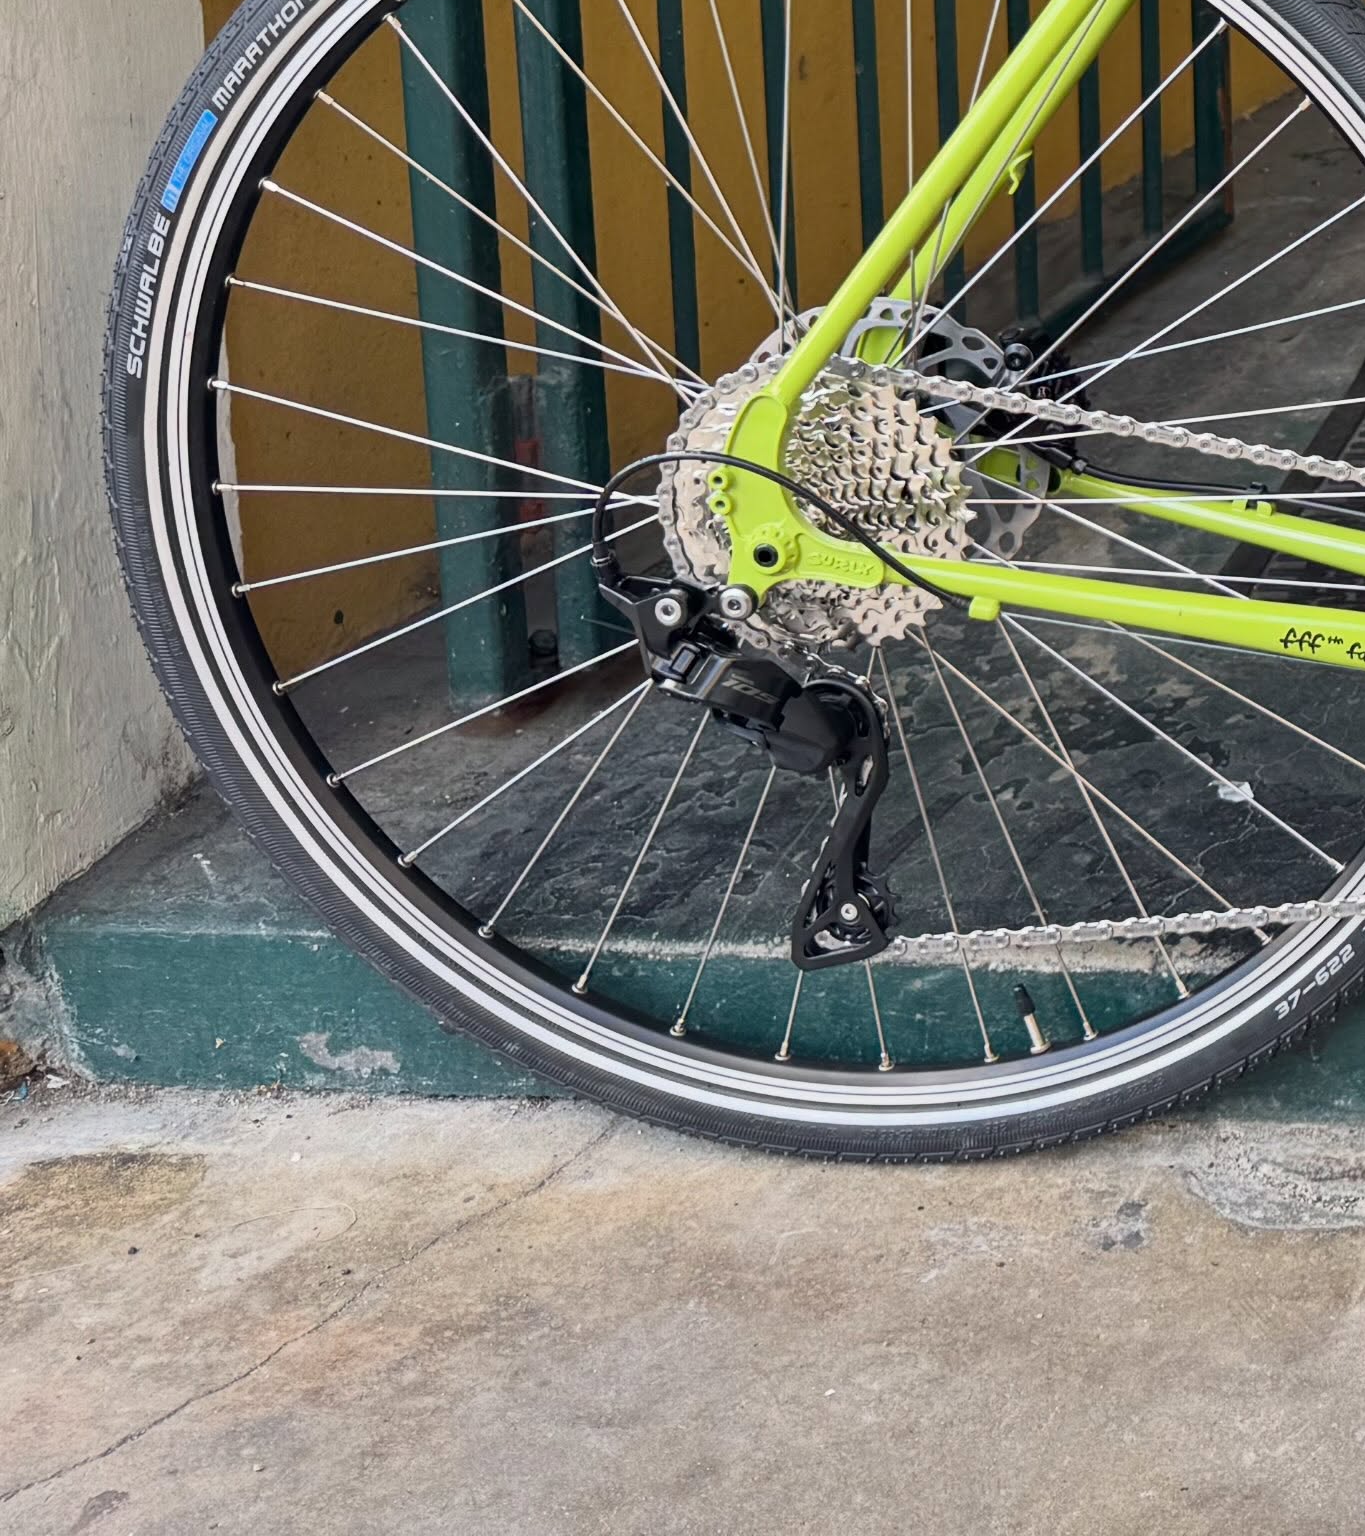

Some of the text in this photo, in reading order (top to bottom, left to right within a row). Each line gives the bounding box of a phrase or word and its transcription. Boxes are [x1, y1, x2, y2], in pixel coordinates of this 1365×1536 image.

[126, 214, 171, 379] SCHWALBE
[722, 680, 780, 705] 105
[1273, 943, 1356, 1021] 37-622
